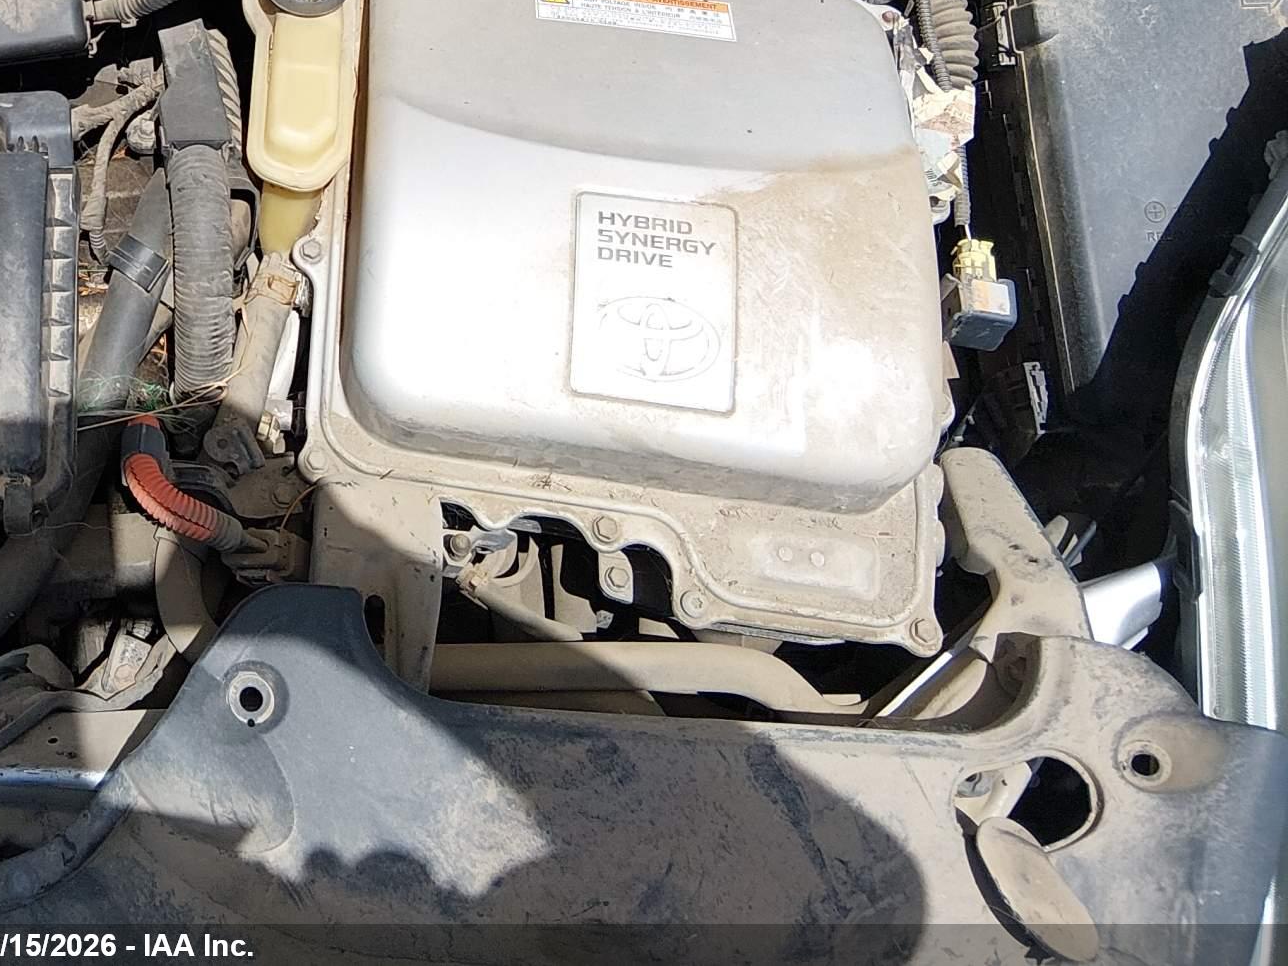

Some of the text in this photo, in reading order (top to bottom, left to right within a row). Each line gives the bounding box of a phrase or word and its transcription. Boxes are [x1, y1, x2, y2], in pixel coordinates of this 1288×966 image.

[598, 211, 693, 235] HYBRID
[597, 228, 717, 256] SYNERGY
[597, 246, 673, 268] DRIVE
